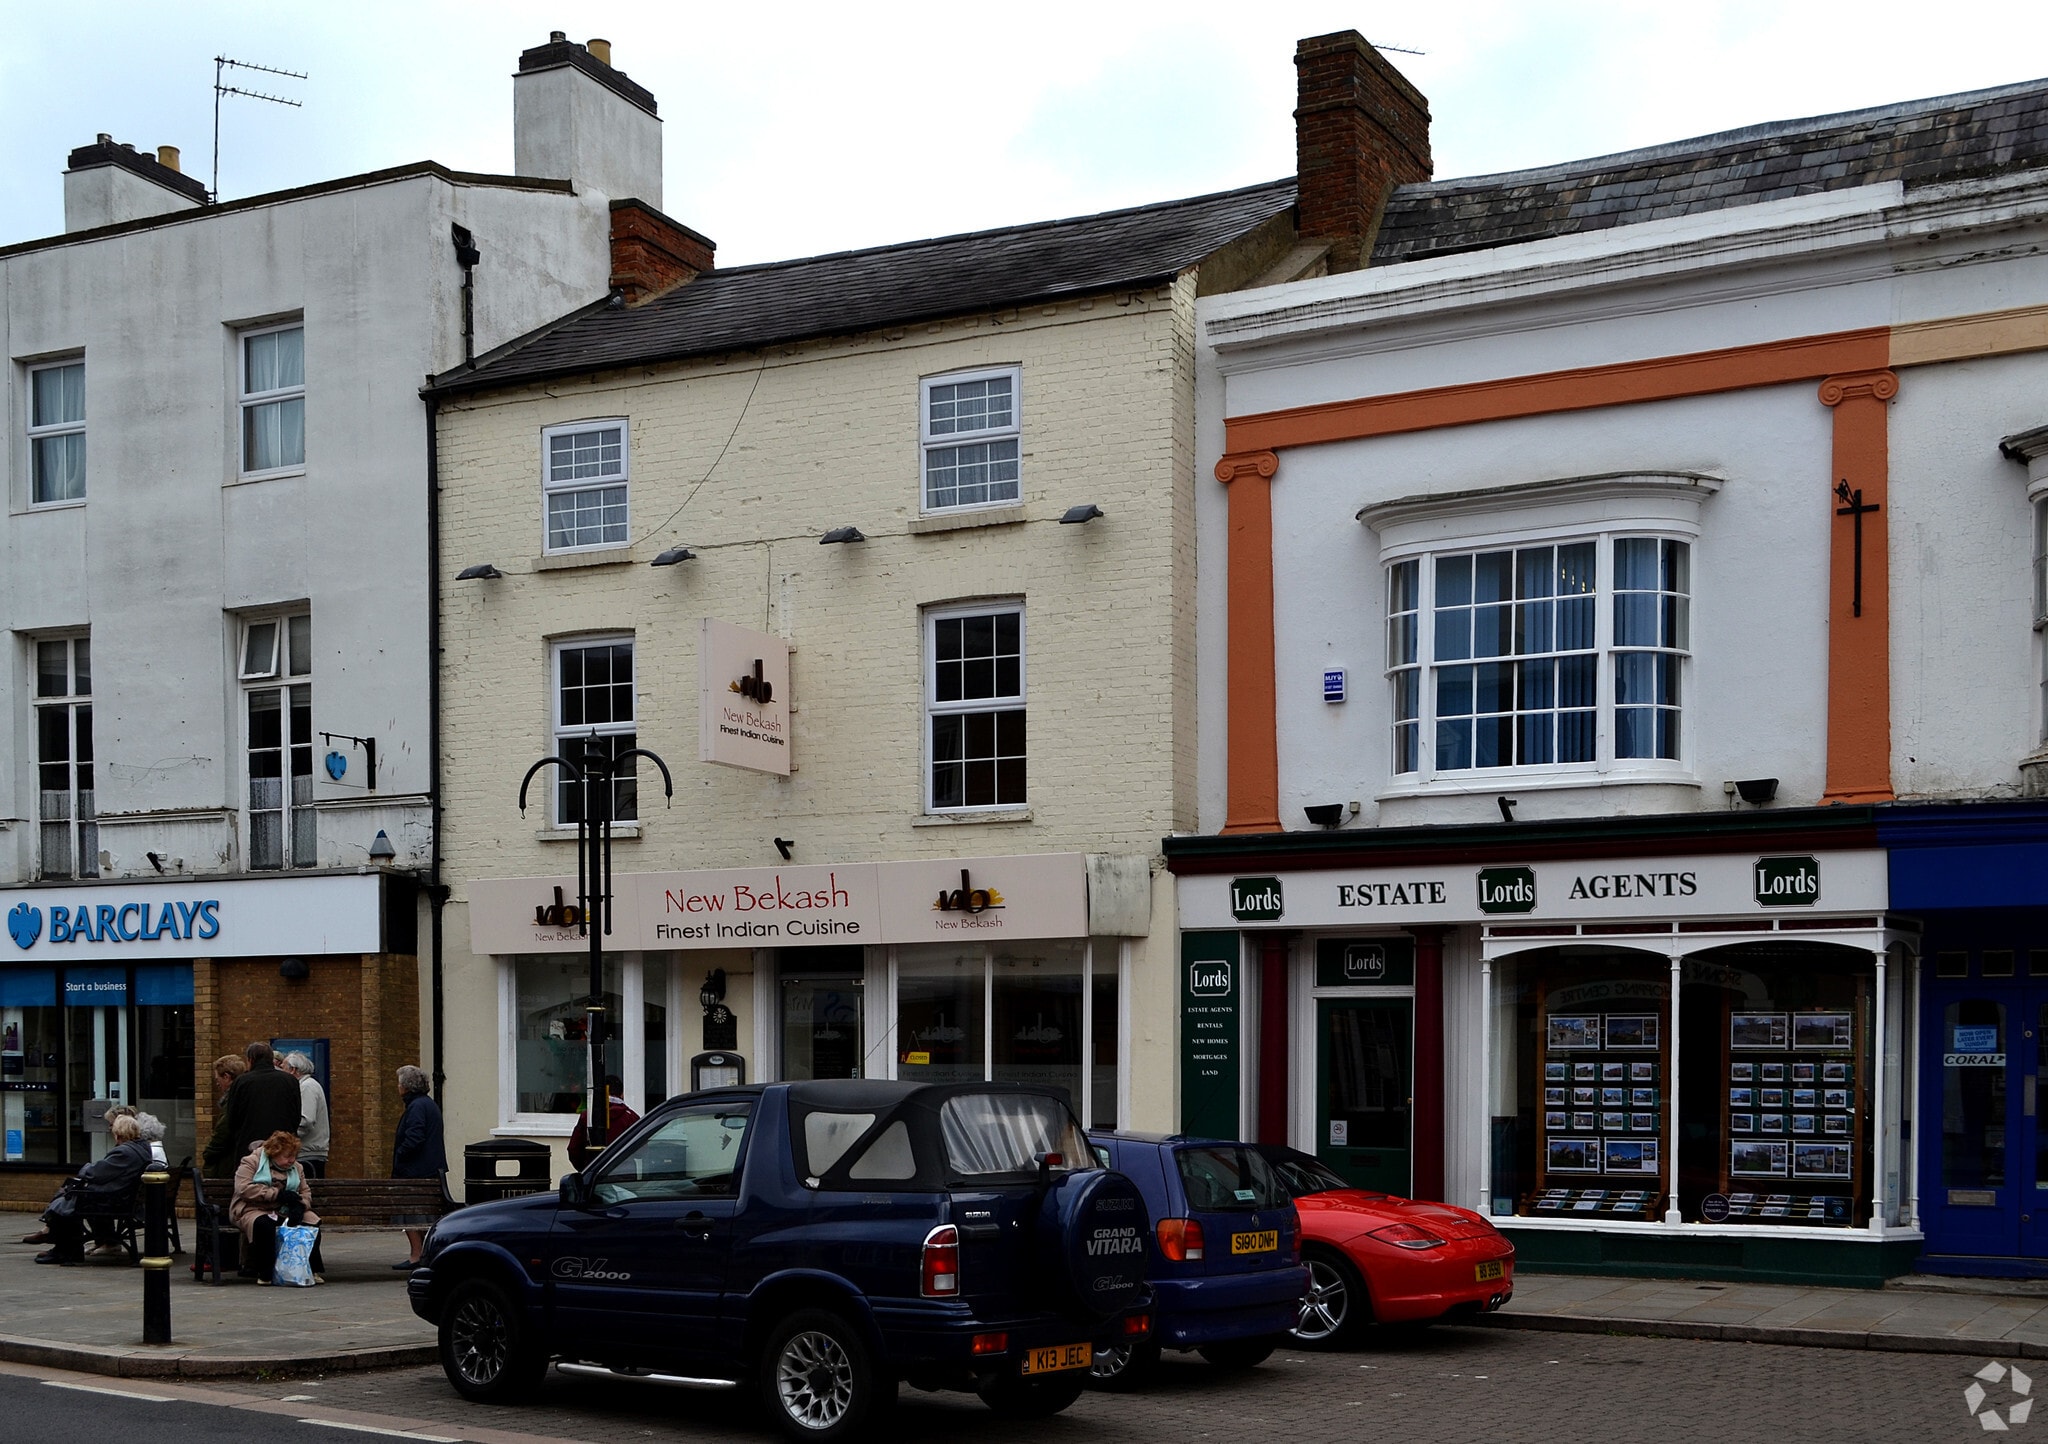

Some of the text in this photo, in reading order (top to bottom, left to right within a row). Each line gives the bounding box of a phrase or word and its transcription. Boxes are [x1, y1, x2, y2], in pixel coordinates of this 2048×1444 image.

[724, 707, 781, 732] New Bekash
[720, 724, 784, 746] Finest Indian Cuisine
[1480, 877, 1533, 904] Lords
[1568, 871, 1697, 900] AGENTS
[1757, 868, 1817, 895] Lords
[665, 872, 849, 913] New Bekash
[1233, 887, 1281, 912] Lords
[1337, 881, 1447, 907] ESTATE
[49, 900, 219, 943] BARCLAYS
[656, 918, 860, 939] Finest Indian Cuisine
[935, 914, 1003, 929] New Bekash
[535, 932, 555, 942] New
[1348, 953, 1382, 970] Lords
[65, 983, 86, 991] Start
[94, 982, 127, 991] business
[1194, 969, 1228, 988] Lords
[1945, 1055, 1997, 1064] CORAL
[1096, 1198, 1135, 1211] SUZUKI
[1093, 1227, 1136, 1239] GRAND
[1235, 1231, 1275, 1251] S190 DNH
[1086, 1237, 1143, 1256] VITARA
[551, 1256, 608, 1278] GV
[582, 1271, 631, 1281] 2000
[1109, 1281, 1134, 1291] 2000
[1037, 1346, 1084, 1370] K13 JEC
